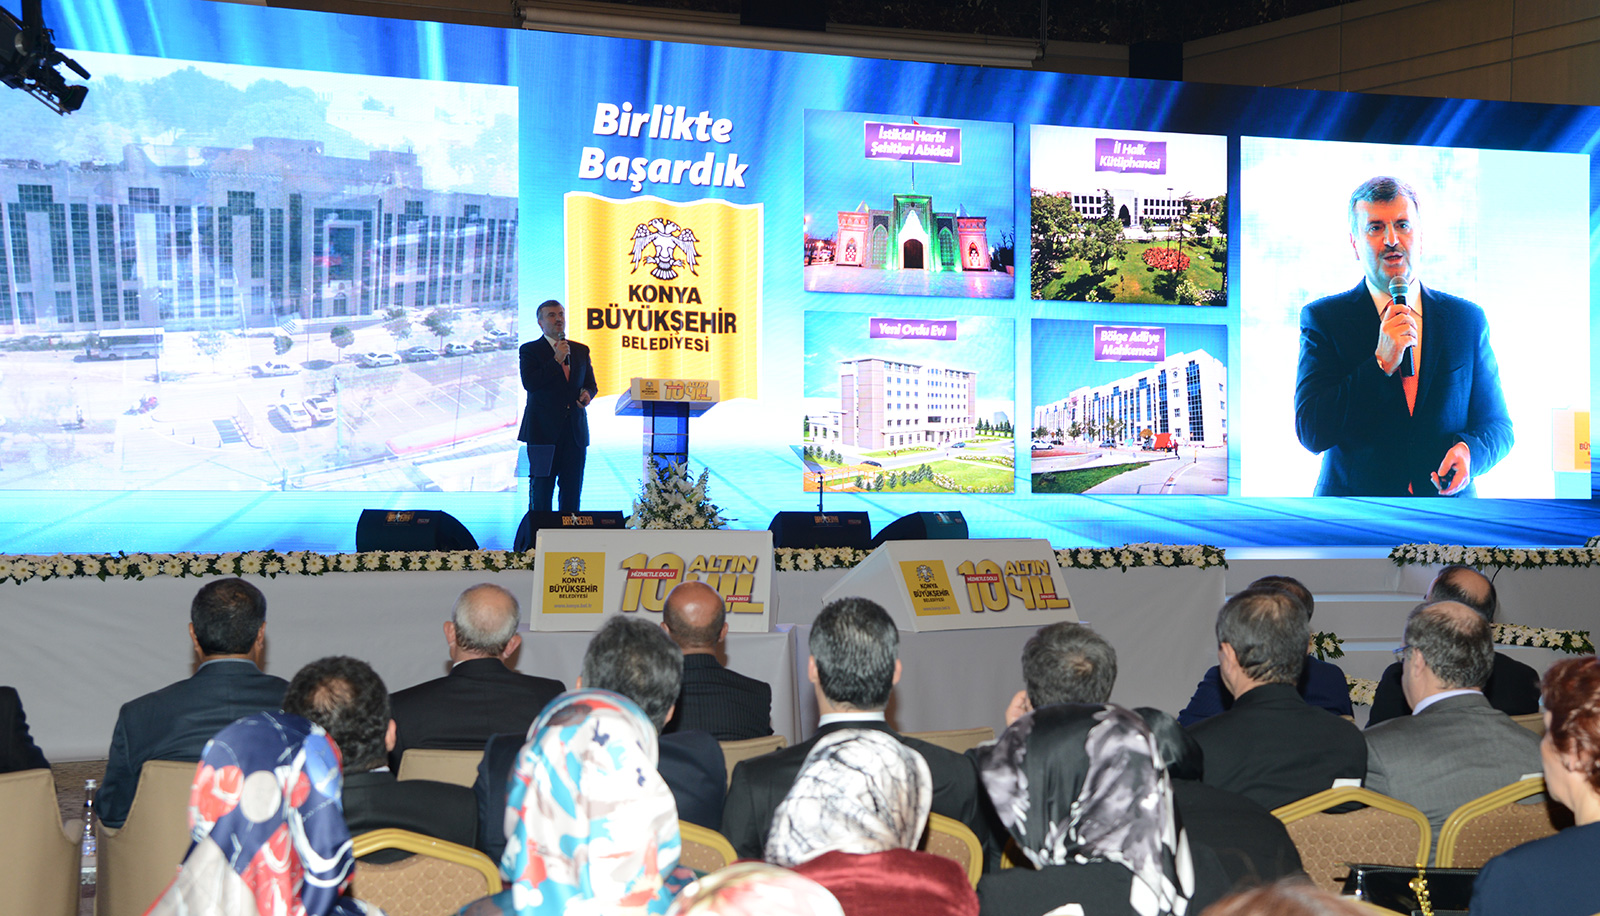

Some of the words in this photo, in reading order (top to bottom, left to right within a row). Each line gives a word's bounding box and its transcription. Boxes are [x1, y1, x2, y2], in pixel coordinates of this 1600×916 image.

[593, 101, 734, 143] Birlikte
[878, 125, 916, 141] İstiklal
[916, 130, 947, 144] Harbi
[871, 141, 915, 156] Şehitleri
[915, 144, 954, 158] Abidesi
[1113, 140, 1122, 154] İl
[1122, 143, 1147, 156] Halk
[578, 146, 749, 192] Başardık
[1099, 155, 1161, 171] Kütüphanesi
[628, 284, 703, 305] KONYA
[587, 303, 737, 335] BÜYÜKŞEHİR
[878, 322, 902, 335] Yeni
[902, 323, 930, 336] Ordu
[930, 324, 948, 337] Evi
[1100, 329, 1129, 345] Bölge
[1129, 330, 1161, 346] Adliye
[622, 333, 709, 353] BELEDİYESİ
[1101, 343, 1159, 357] Mahkemesi
[688, 554, 757, 573] ALTIN
[1005, 560, 1049, 575] ALTIN
[549, 583, 598, 593] BÜYÜKŞEHİR
[621, 552, 686, 612] 10
[957, 559, 1008, 611] 10
[1005, 575, 1070, 610] YIL
